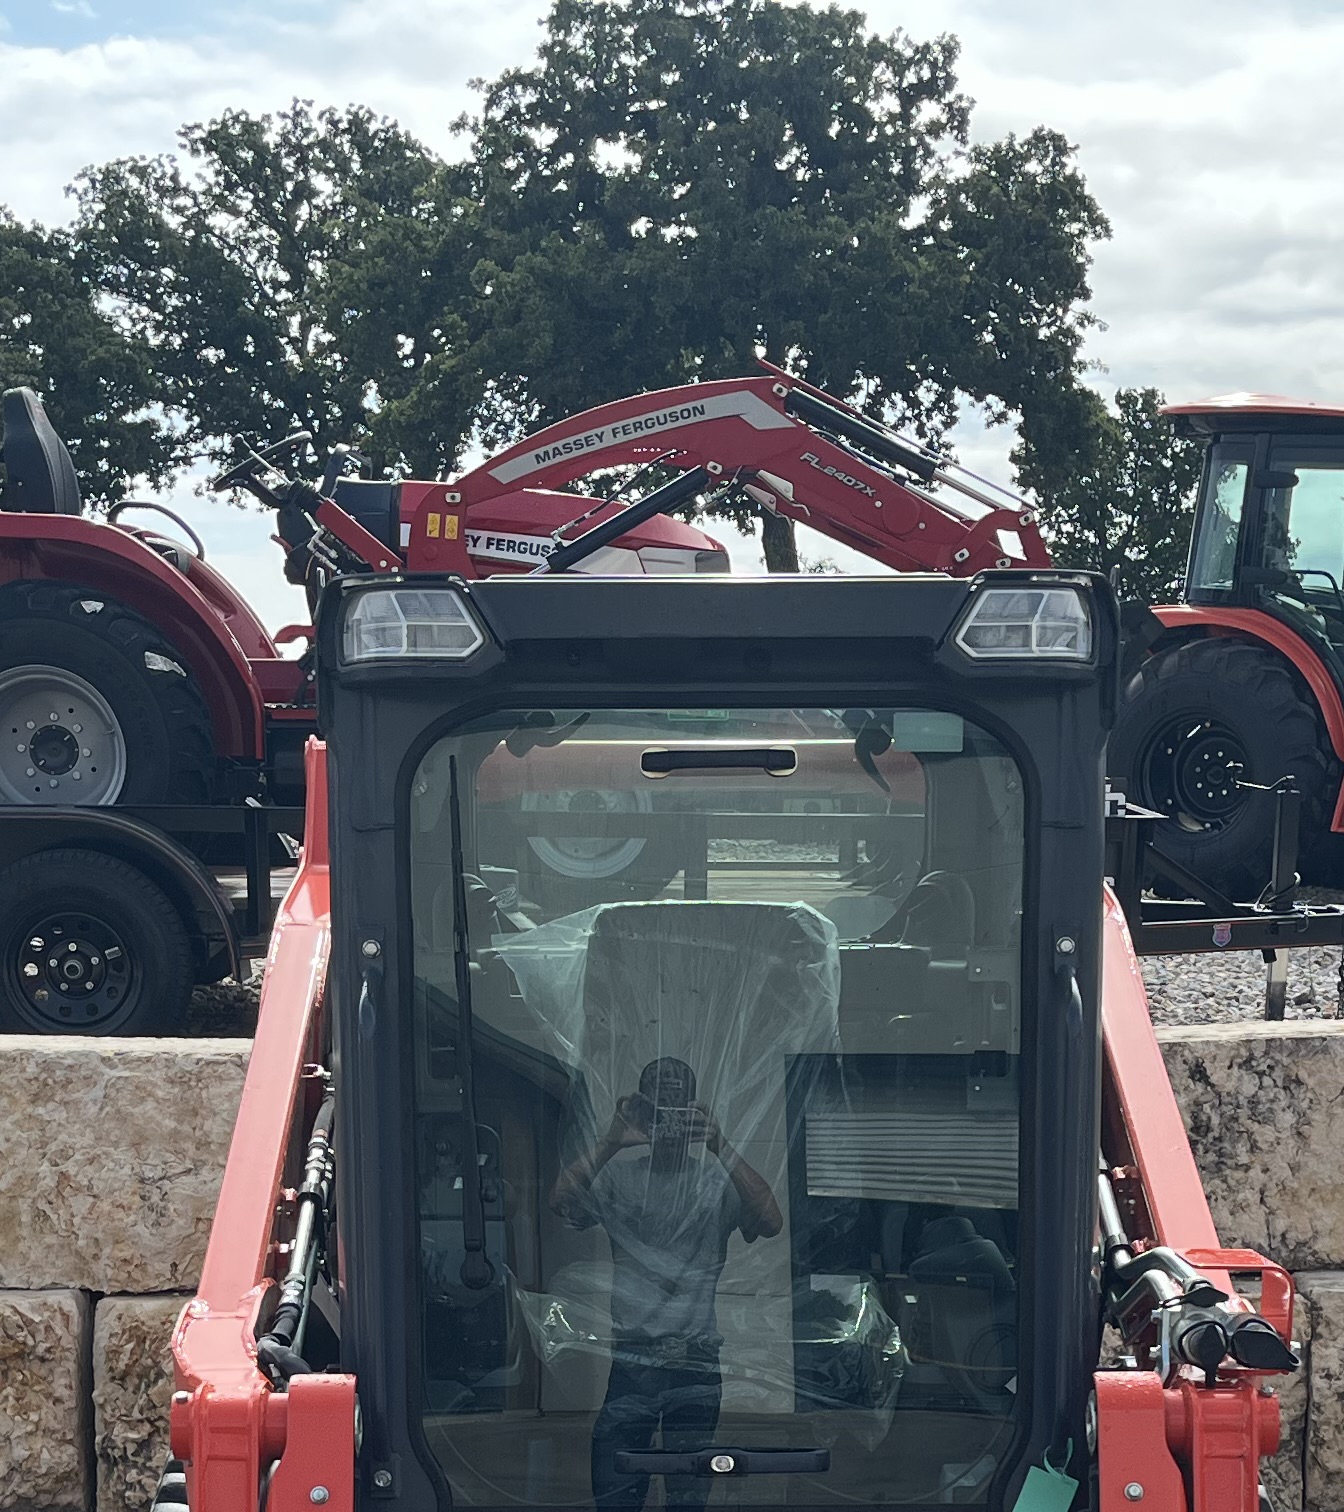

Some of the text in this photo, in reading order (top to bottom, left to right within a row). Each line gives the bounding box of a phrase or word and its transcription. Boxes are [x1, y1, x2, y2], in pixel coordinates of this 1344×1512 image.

[534, 404, 707, 465] MASSEY FERGUSON
[485, 537, 557, 557] FERGUS
